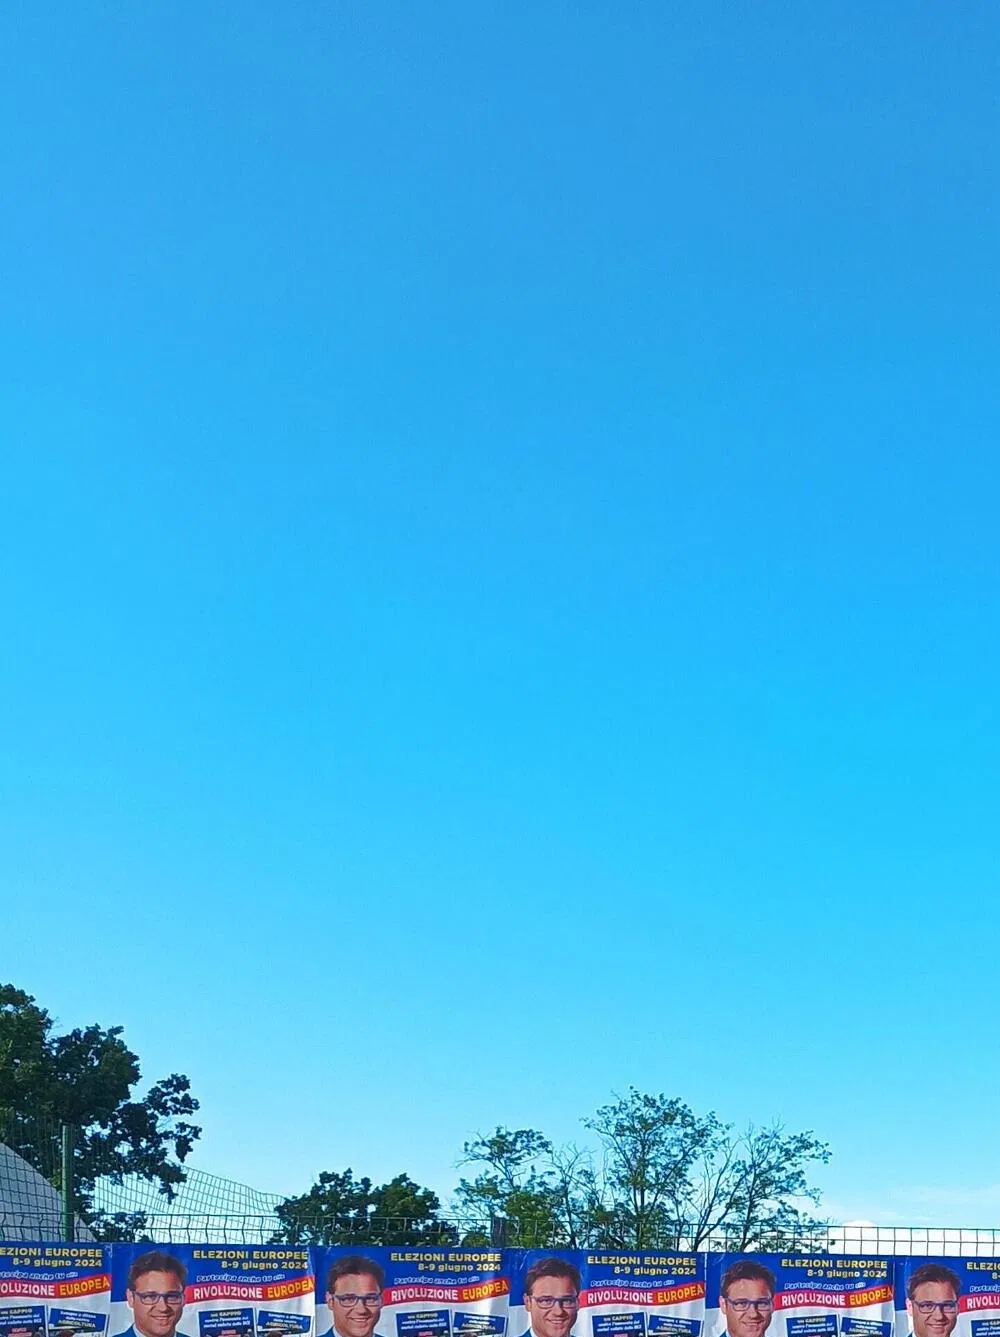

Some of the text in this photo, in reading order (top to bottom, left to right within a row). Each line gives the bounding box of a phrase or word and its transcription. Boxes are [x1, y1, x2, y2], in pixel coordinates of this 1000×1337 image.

[0, 1248, 102, 1257] EZIONI EUROPEE
[193, 1251, 308, 1259] ELEZIONI EUROPEE
[390, 1253, 502, 1262] ELEZIONI EUROPEE
[35, 1258, 71, 1268] giugno
[75, 1258, 102, 1267] 2024
[243, 1261, 278, 1271] giugno
[282, 1261, 308, 1269] 2024
[644, 1257, 696, 1265] EUROPEE
[836, 1260, 887, 1268] EUROPEE
[439, 1263, 473, 1273] giugno
[476, 1263, 502, 1271] 2024
[634, 1267, 668, 1276] giugno
[827, 1270, 860, 1279] giugno
[0, 1276, 108, 1296] OLUZIONE EUROPEA
[194, 1278, 314, 1299] RIVOLUZIONE EUROPEA
[391, 1280, 508, 1301] RIVOLUZIONE EUROPEA
[588, 1283, 702, 1303] RIVOLUZIONE EUROPEA
[782, 1286, 893, 1306] RIVOLUZIONE EUROPEA
